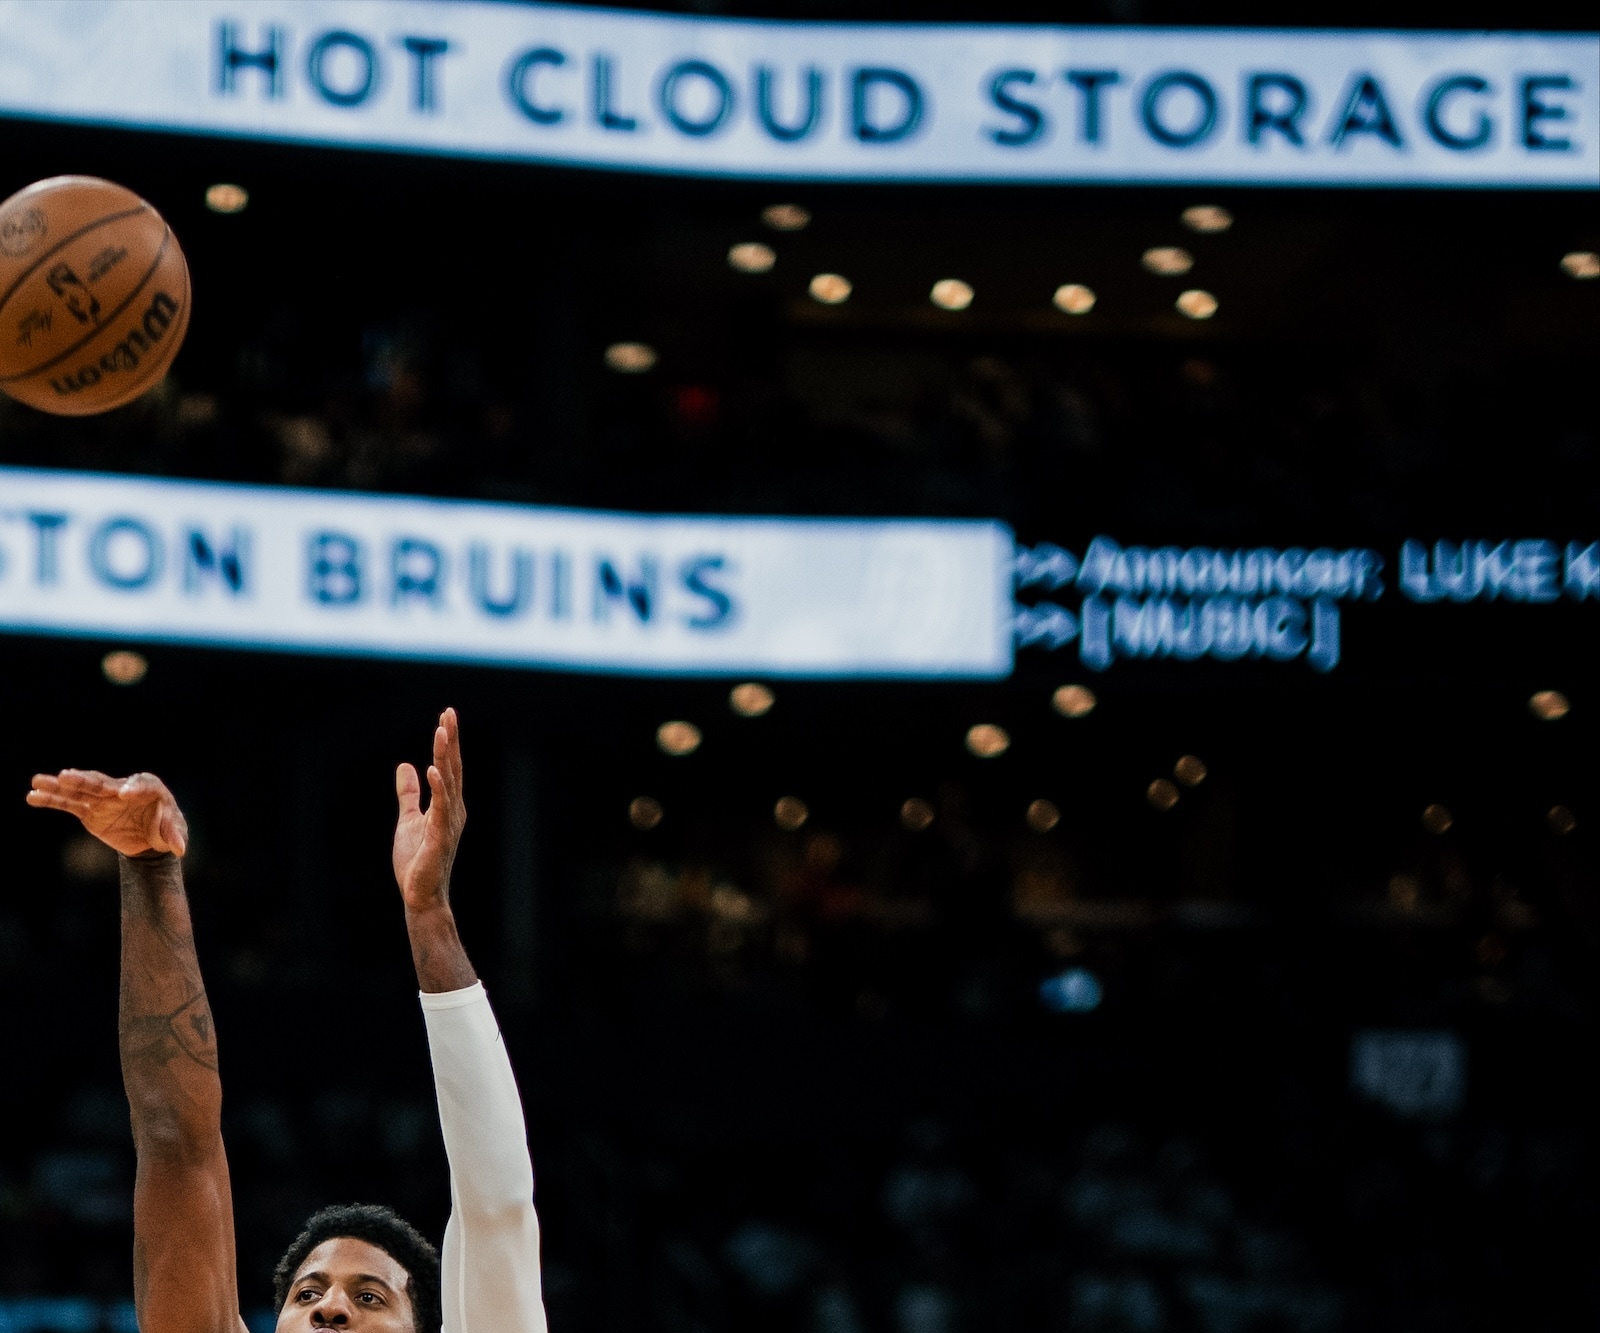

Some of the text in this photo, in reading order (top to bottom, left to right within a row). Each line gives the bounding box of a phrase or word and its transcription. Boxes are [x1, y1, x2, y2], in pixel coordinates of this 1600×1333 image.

[212, 20, 1576, 154] HOT CLOUD STORAGE
[308, 527, 740, 634] BRUINS
[1400, 538, 1560, 601] LUKE
